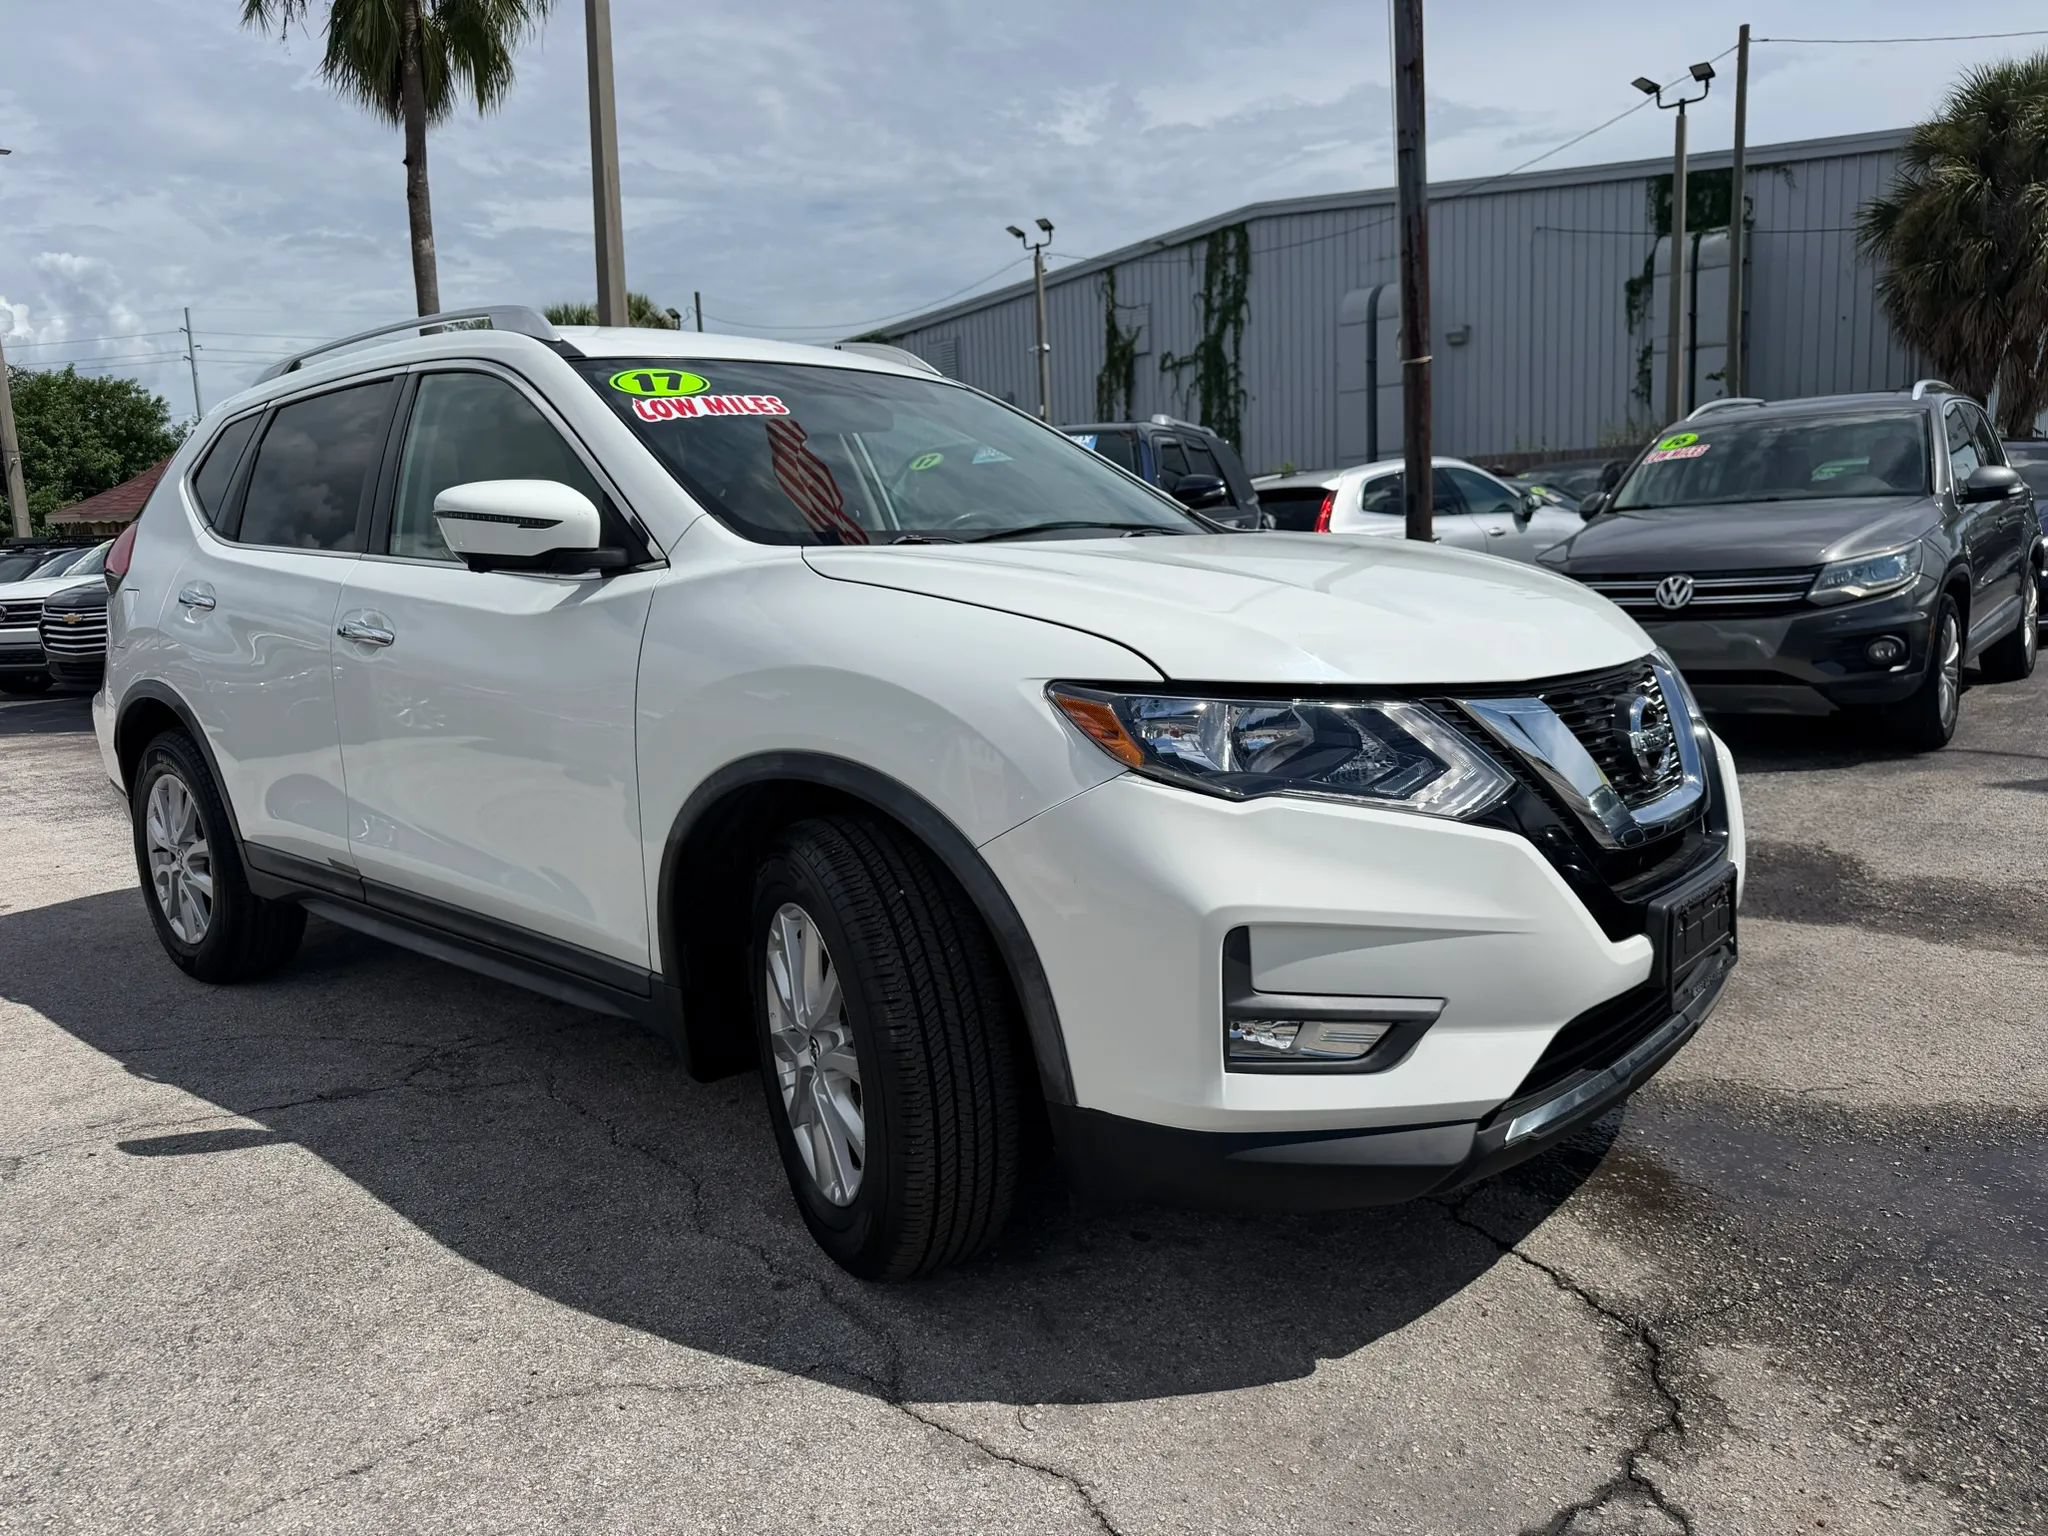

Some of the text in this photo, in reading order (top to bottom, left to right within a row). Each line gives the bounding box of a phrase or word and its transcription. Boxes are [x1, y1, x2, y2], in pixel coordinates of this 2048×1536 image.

[632, 373, 682, 392] 17
[635, 396, 787, 420] LOW MILES
